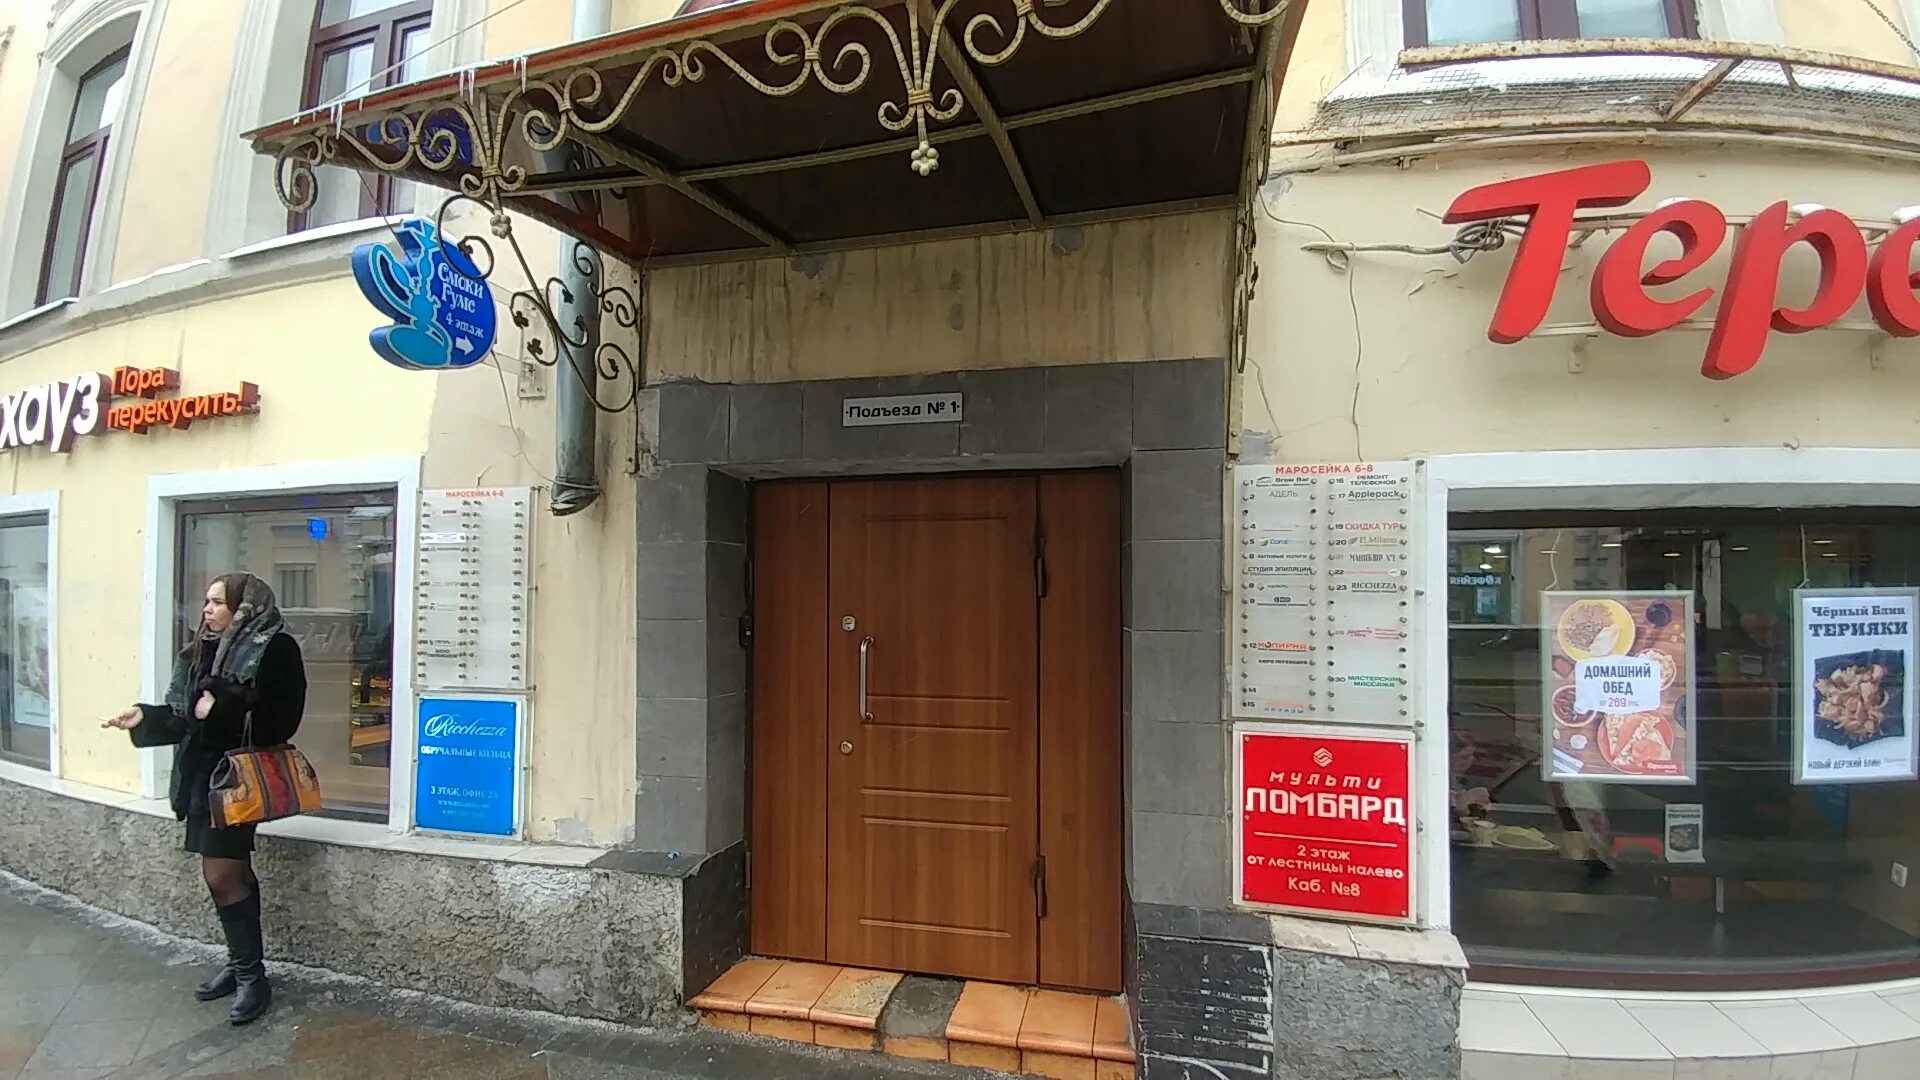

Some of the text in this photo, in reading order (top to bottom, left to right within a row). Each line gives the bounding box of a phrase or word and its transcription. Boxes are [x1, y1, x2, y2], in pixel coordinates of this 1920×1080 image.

[445, 312, 484, 338] 4 этаж
[111, 366, 166, 397] Пора
[107, 381, 244, 434] перекусить!
[849, 400, 957, 418] Подъезд № 1
[1275, 463, 1374, 475] МАРОСЕЙКА 6-8
[1348, 490, 1400, 499] Applepack
[1345, 523, 1381, 531] СКИДКА
[1811, 605, 1906, 619] Чёрный Блин
[1808, 621, 1908, 637] ТЕРИЯКИ
[1584, 662, 1651, 680] ДОМАШНИЙ
[1602, 681, 1634, 696] ОБЕД
[1608, 698, 1626, 708] 269
[424, 713, 508, 739] Ricchezza
[420, 746, 477, 757] ОБРУЧАЛЬНЫЕ
[430, 785, 436, 795] 3
[1246, 787, 1406, 826] ЛОМБАРД
[1297, 844, 1351, 861] 2 этаж
[1246, 856, 1404, 879] от лестницы налево
[1288, 876, 1361, 897] Каб. №8
